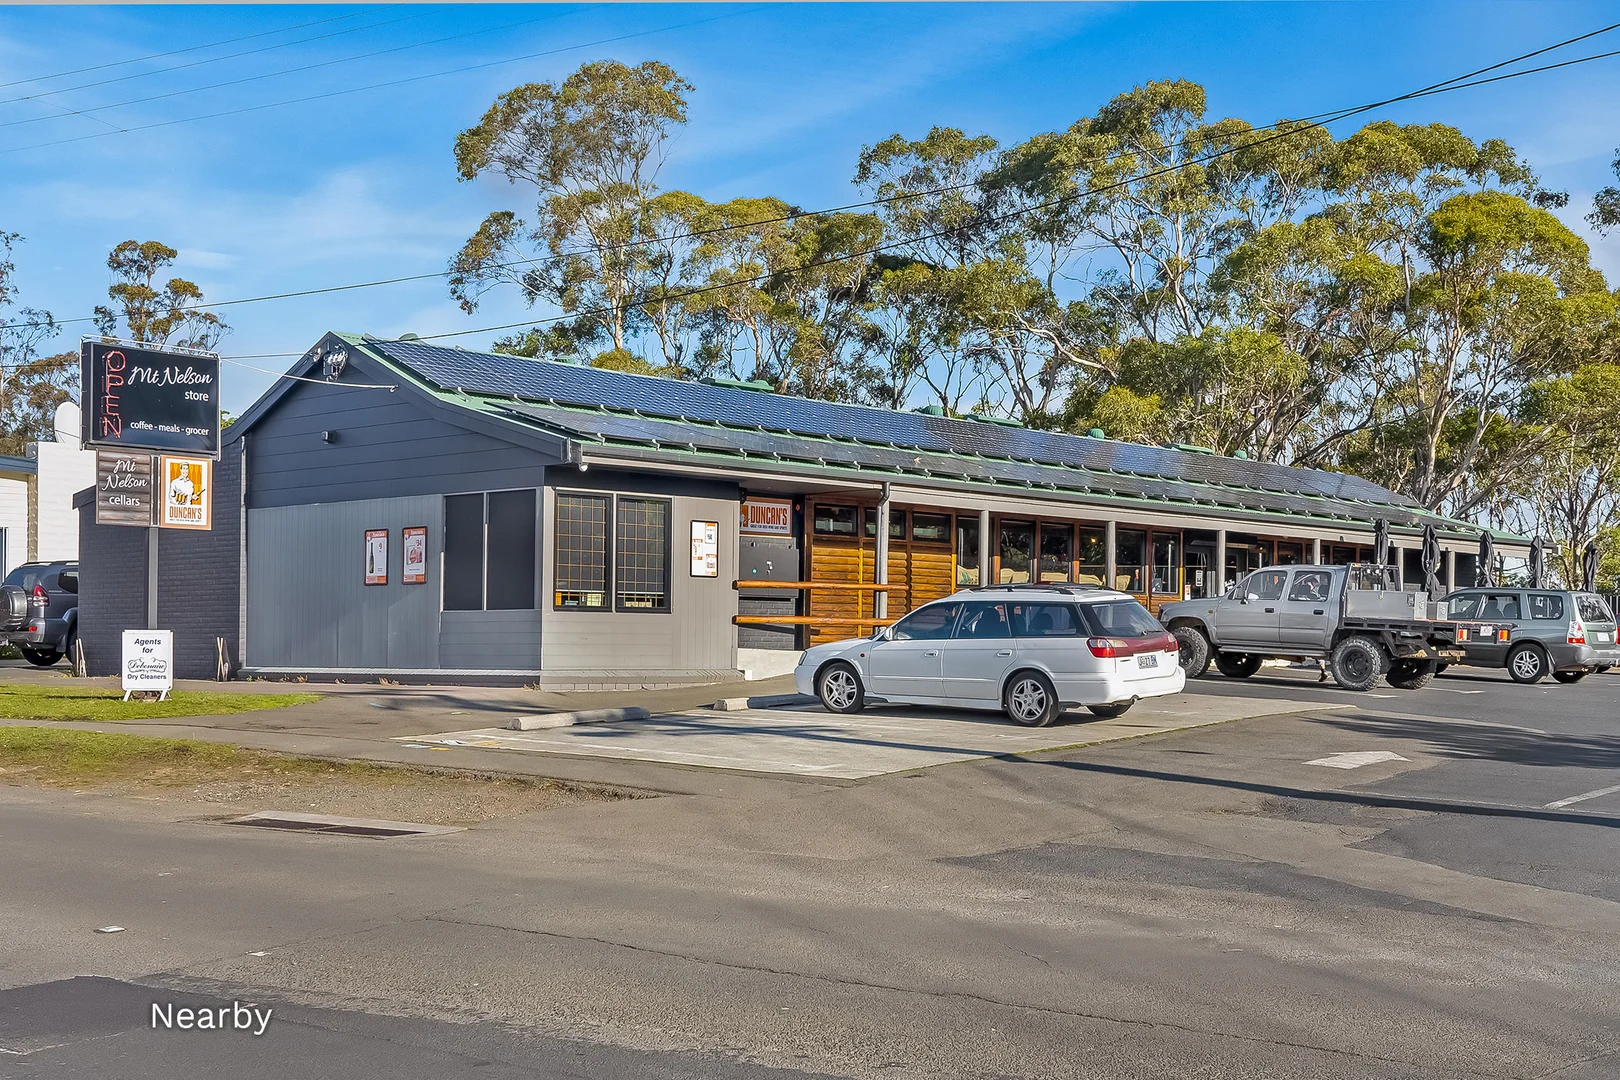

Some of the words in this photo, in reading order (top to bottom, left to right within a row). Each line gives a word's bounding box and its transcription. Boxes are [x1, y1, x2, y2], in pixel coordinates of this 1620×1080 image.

[128, 366, 159, 385] Mt
[158, 366, 213, 387] Nelson
[103, 351, 126, 438] OPEN
[185, 390, 209, 401] store
[130, 420, 153, 431] coffee
[158, 423, 180, 433] meals
[185, 428, 209, 436] grocer
[113, 459, 137, 474] Mt
[102, 474, 148, 491] Nelson
[109, 494, 140, 507] cellars
[169, 506, 202, 520] DUNCAN'S
[750, 505, 788, 526] DUNCAN'S
[134, 638, 162, 646] Agents
